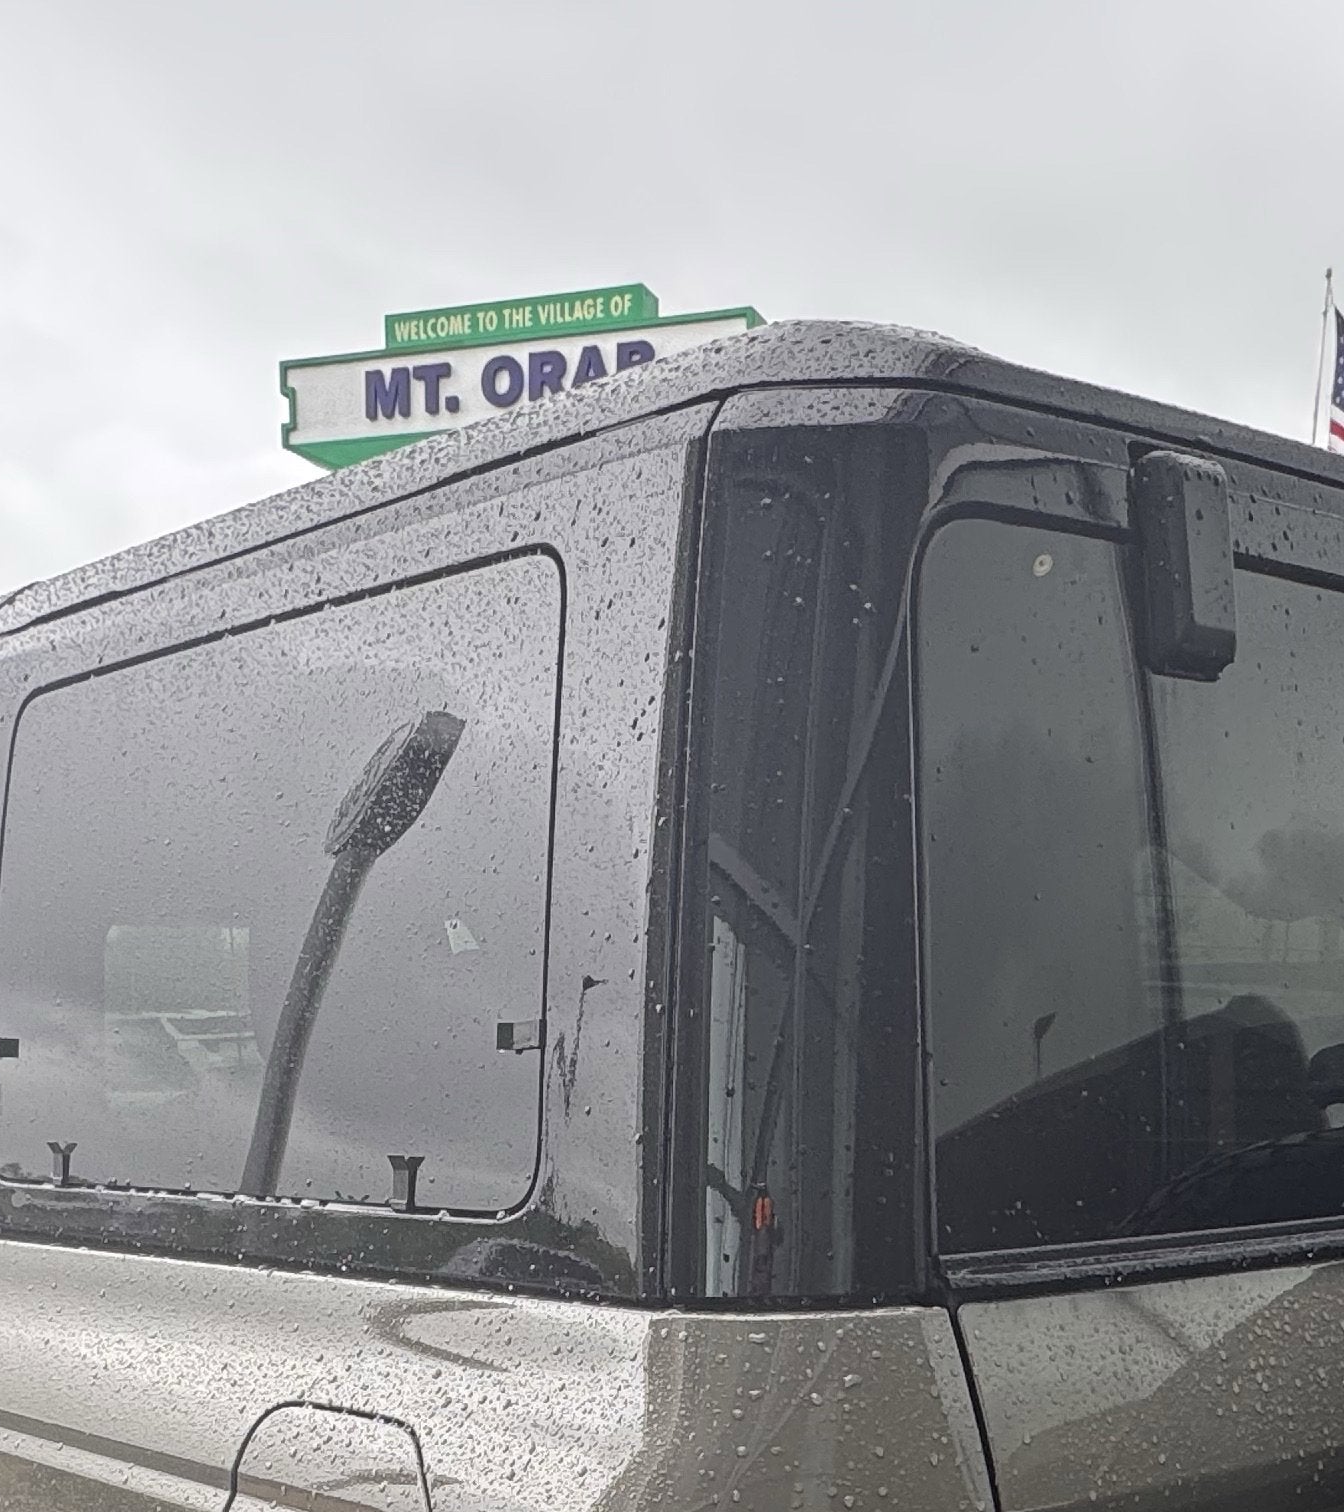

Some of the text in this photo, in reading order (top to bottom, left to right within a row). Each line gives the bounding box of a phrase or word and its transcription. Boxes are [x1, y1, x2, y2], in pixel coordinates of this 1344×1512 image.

[394, 293, 633, 342] WELCOME TO THE VILLAGE OF
[365, 362, 460, 422] MT.
